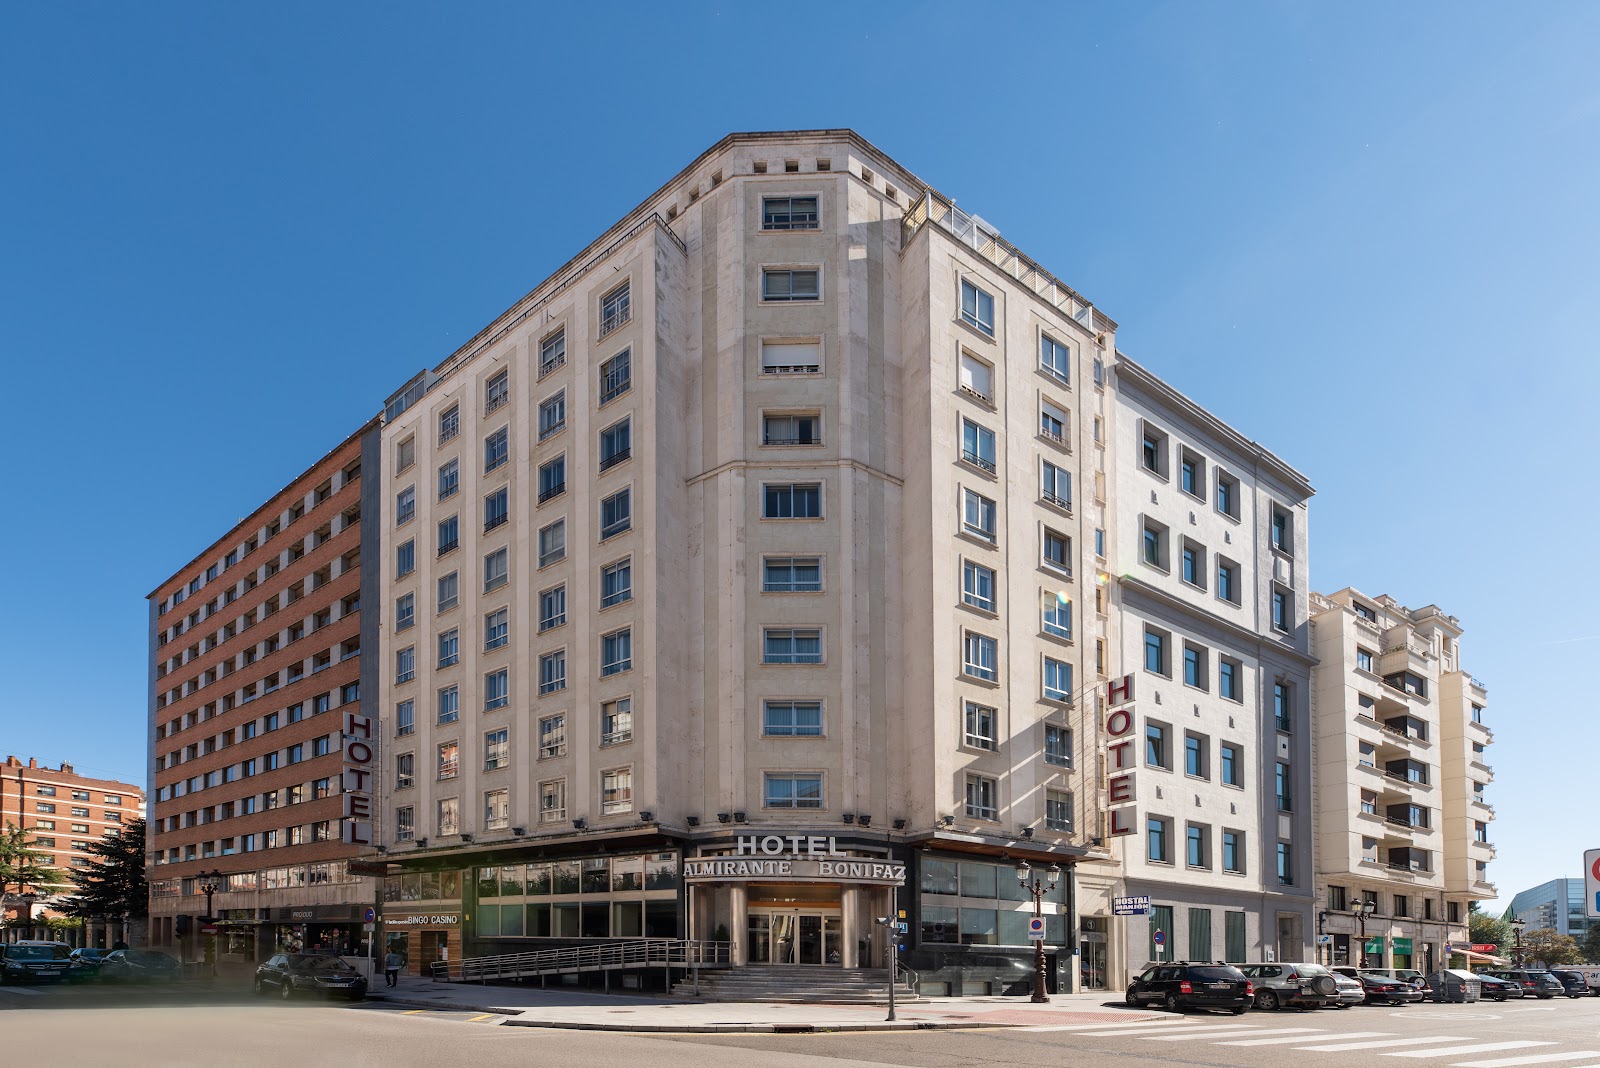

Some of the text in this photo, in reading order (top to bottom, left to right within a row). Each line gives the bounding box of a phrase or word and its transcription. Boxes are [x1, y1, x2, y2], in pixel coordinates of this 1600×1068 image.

[1107, 675, 1131, 835] HOTEL
[348, 714, 372, 844] HOTEL
[737, 836, 847, 856] HOTEL
[683, 861, 907, 880] ALMIRANTE BONIFAZ
[1115, 897, 1149, 905] HOSTAL
[408, 916, 429, 924] BINGO
[431, 915, 458, 924] CASINO
